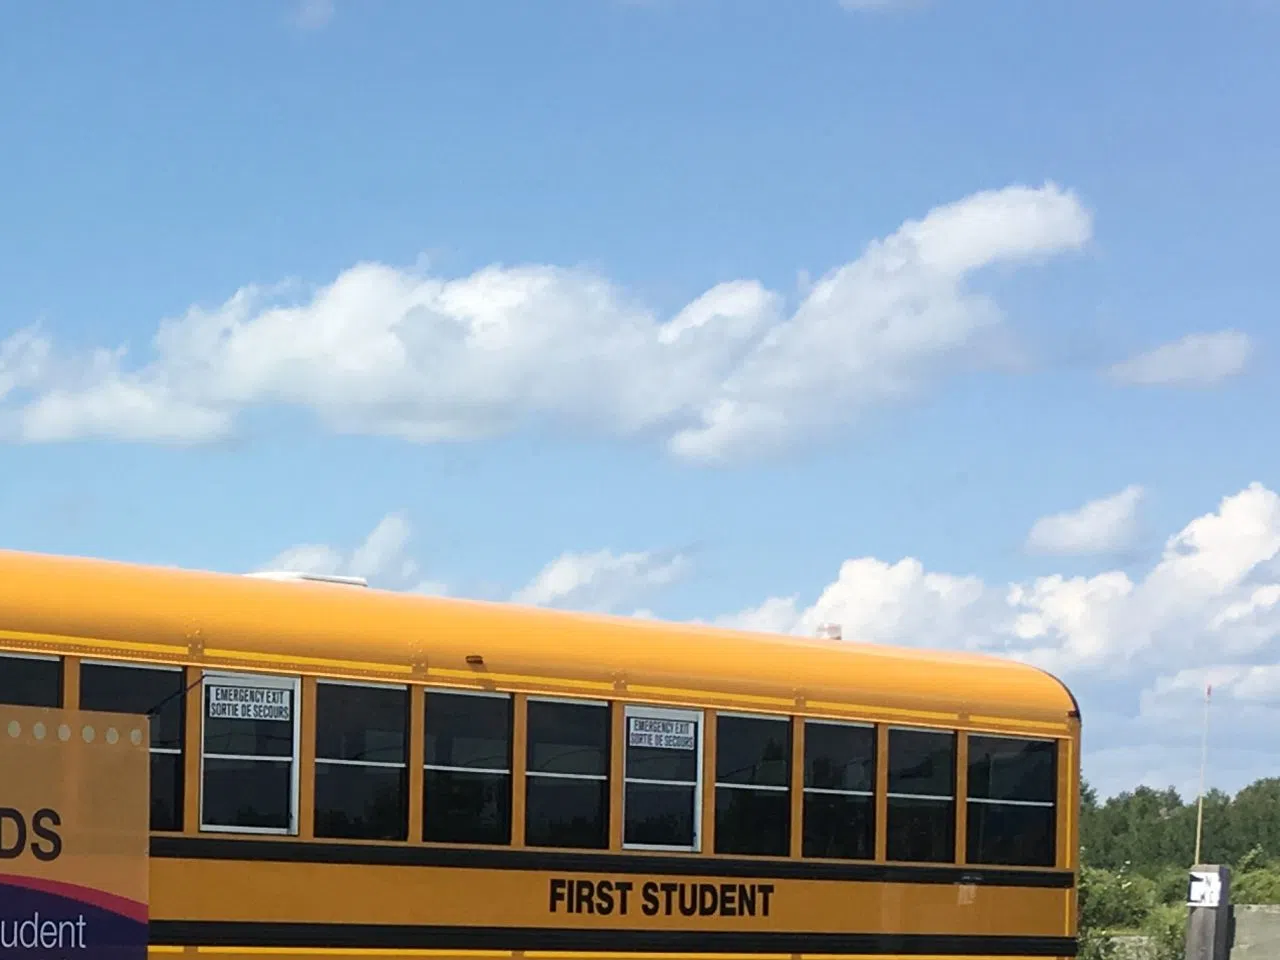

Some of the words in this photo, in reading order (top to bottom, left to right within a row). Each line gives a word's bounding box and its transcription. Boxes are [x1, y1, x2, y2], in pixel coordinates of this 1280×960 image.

[215, 687, 265, 703] EMERGENCY
[266, 690, 284, 704] EXIT
[211, 702, 238, 717] SORTIE
[241, 703, 252, 717] DE
[253, 704, 289, 719] SECOURS
[634, 719, 674, 734] EMERGENCY
[675, 722, 689, 735] EXIT
[631, 732, 653, 746] SORTIE
[654, 733, 663, 746] DE
[549, 879, 633, 915] FIRST
[641, 882, 774, 917] STUDENT
